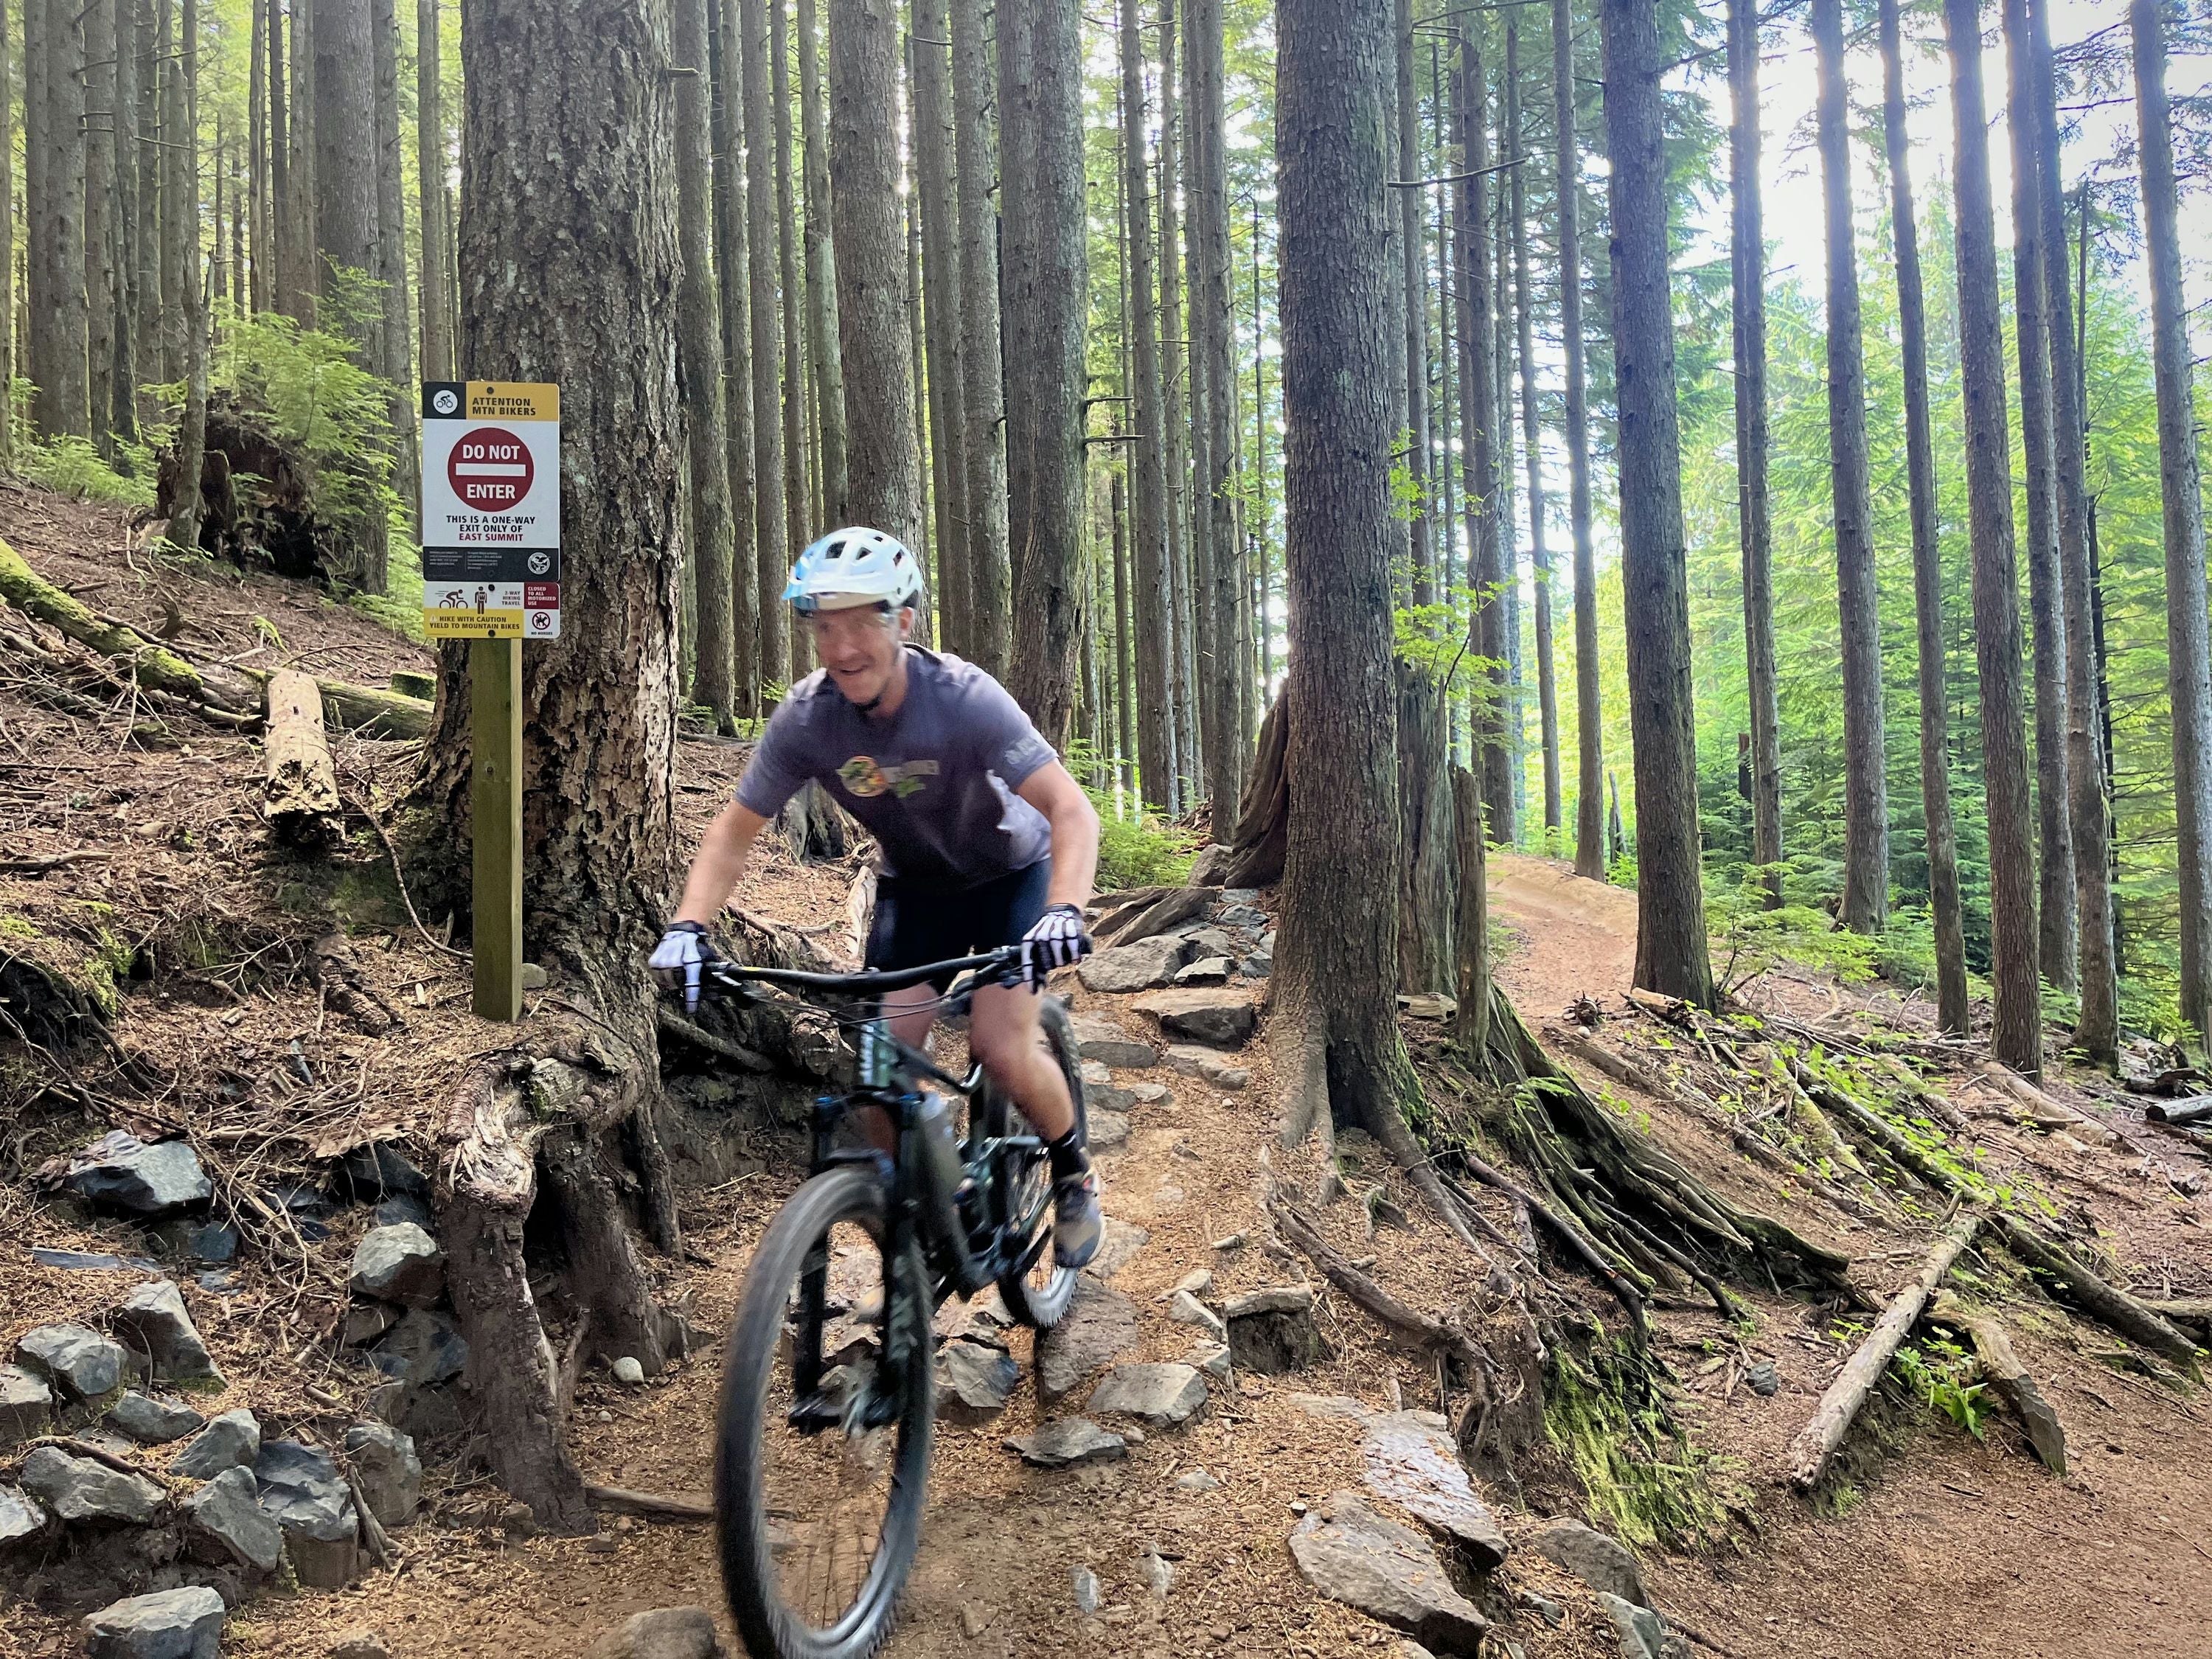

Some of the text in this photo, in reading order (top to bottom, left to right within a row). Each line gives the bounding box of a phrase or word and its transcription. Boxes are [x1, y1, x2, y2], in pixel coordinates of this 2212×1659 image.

[472, 397, 530, 406] ATTENTION
[472, 407, 536, 416] MTN BIKERS
[462, 445, 520, 460] DO NOT
[467, 484, 515, 499] ENTER
[446, 515, 535, 524] THIS IS A ONE-WAY
[459, 524, 480, 532] EXIT
[485, 533, 524, 541] SUMMIT
